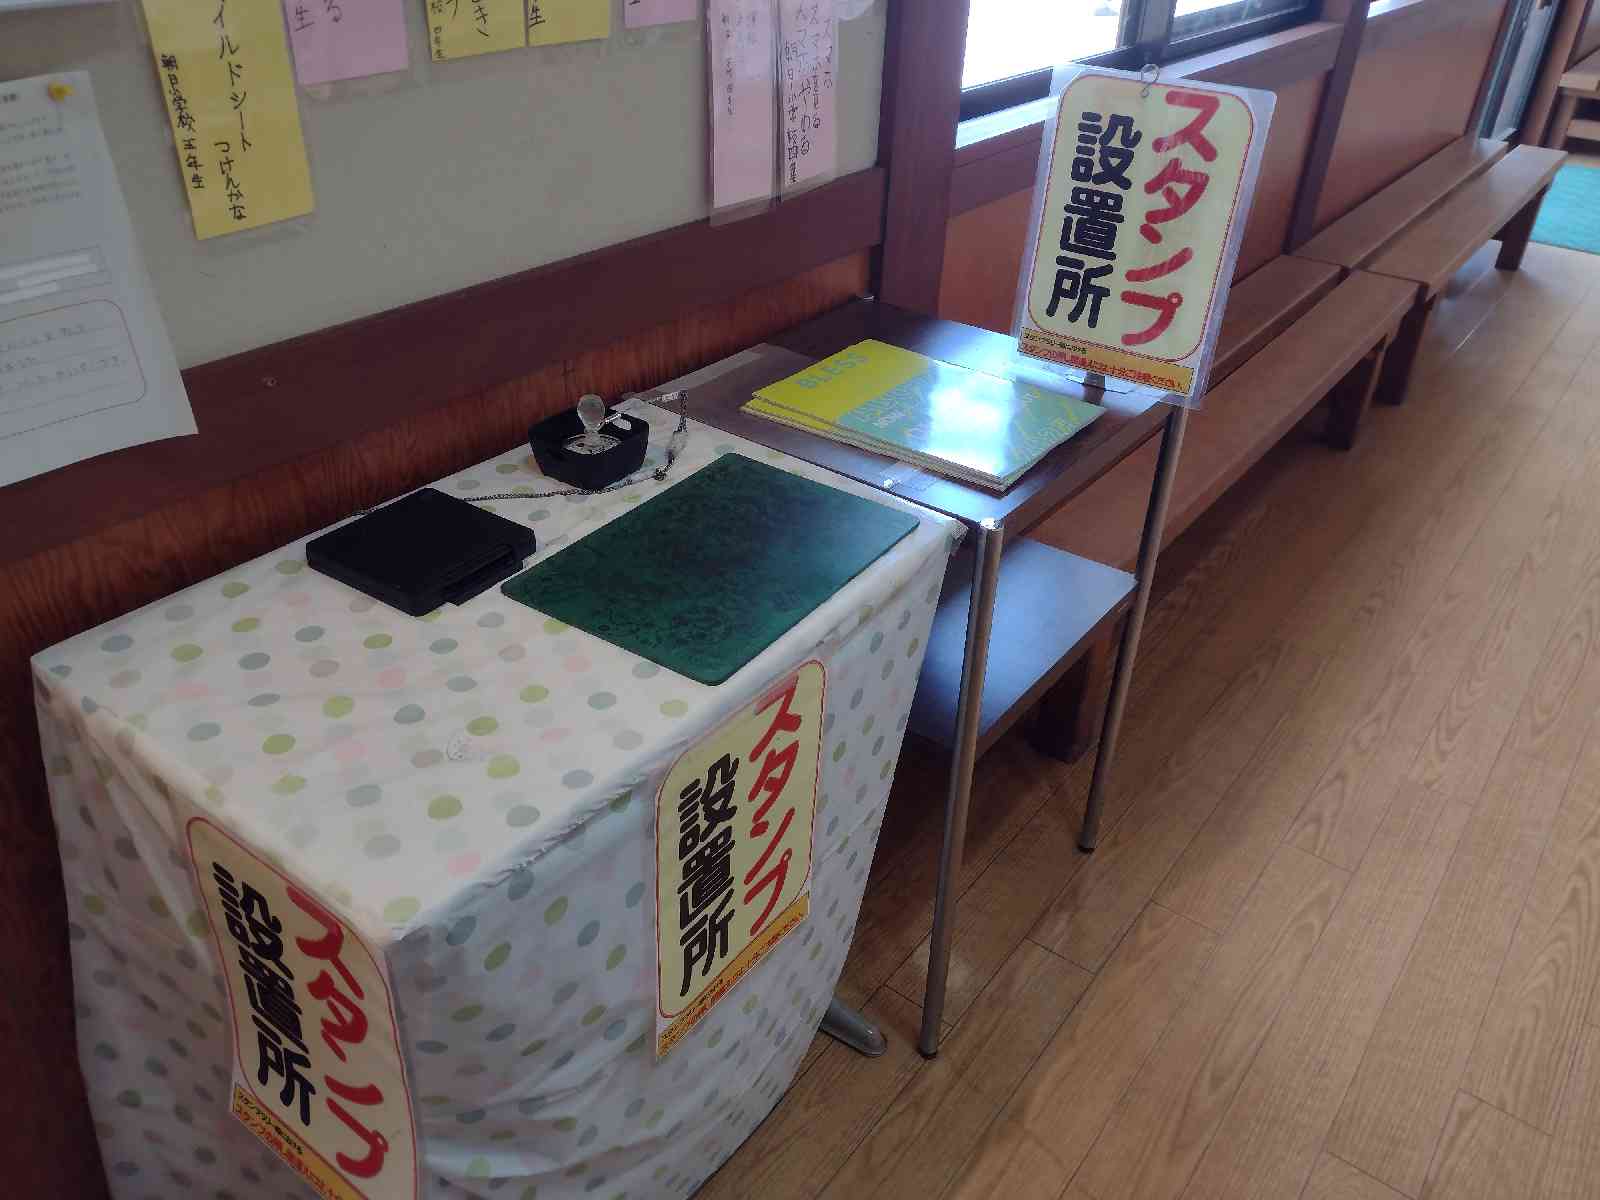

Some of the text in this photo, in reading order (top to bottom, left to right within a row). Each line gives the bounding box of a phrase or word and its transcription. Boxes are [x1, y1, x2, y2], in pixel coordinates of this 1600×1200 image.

[1046, 111, 1142, 329] 設置所
[1120, 90, 1221, 346] スタンプ
[678, 753, 740, 997] 設置所
[744, 675, 801, 936] スタンプ
[212, 861, 316, 1127] 設置所
[286, 886, 389, 1178] スタンプ
